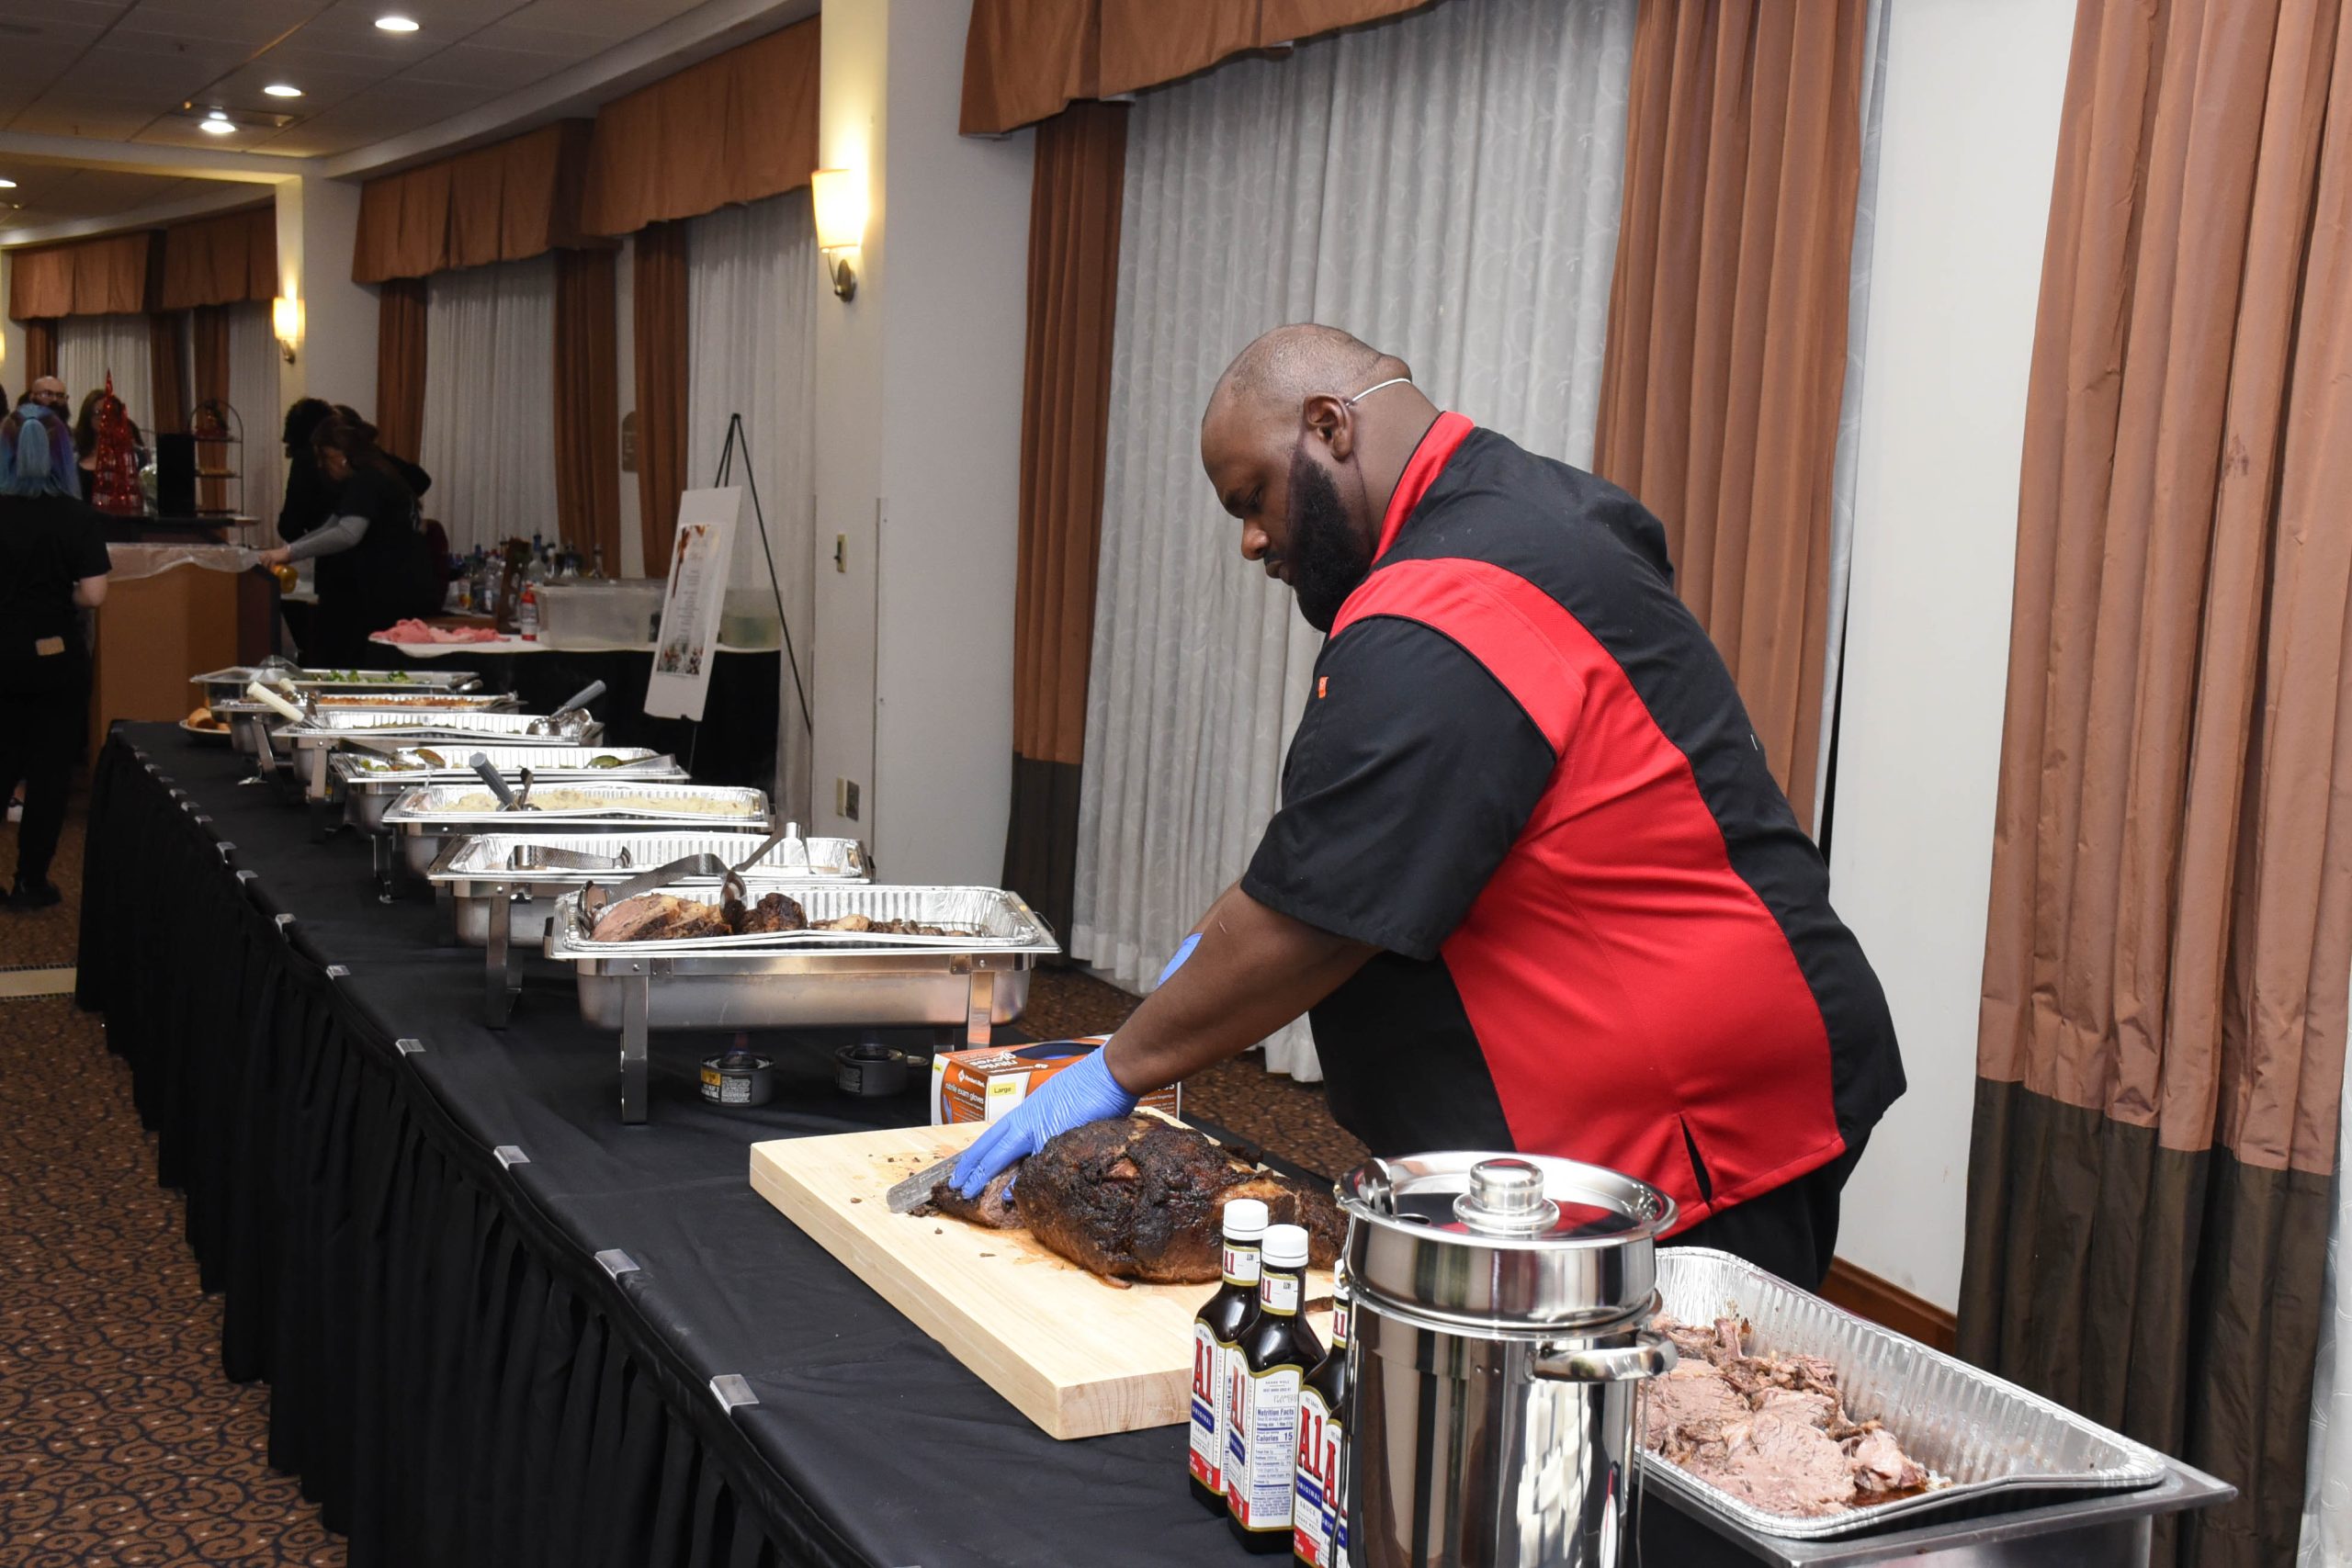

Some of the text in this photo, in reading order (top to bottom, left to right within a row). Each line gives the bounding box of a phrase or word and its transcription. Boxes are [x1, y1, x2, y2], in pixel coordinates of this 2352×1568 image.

[969, 1092, 984, 1104] gloves
[1333, 1310, 1346, 1338] A1
[1193, 1337, 1214, 1408] A1
[1230, 1364, 1245, 1439] A1
[1192, 1404, 1213, 1427] ORIGINAL
[1283, 1432, 1293, 1441] 15
[1297, 1405, 1324, 1482] A1
[1299, 1501, 1317, 1517] SAUCE
